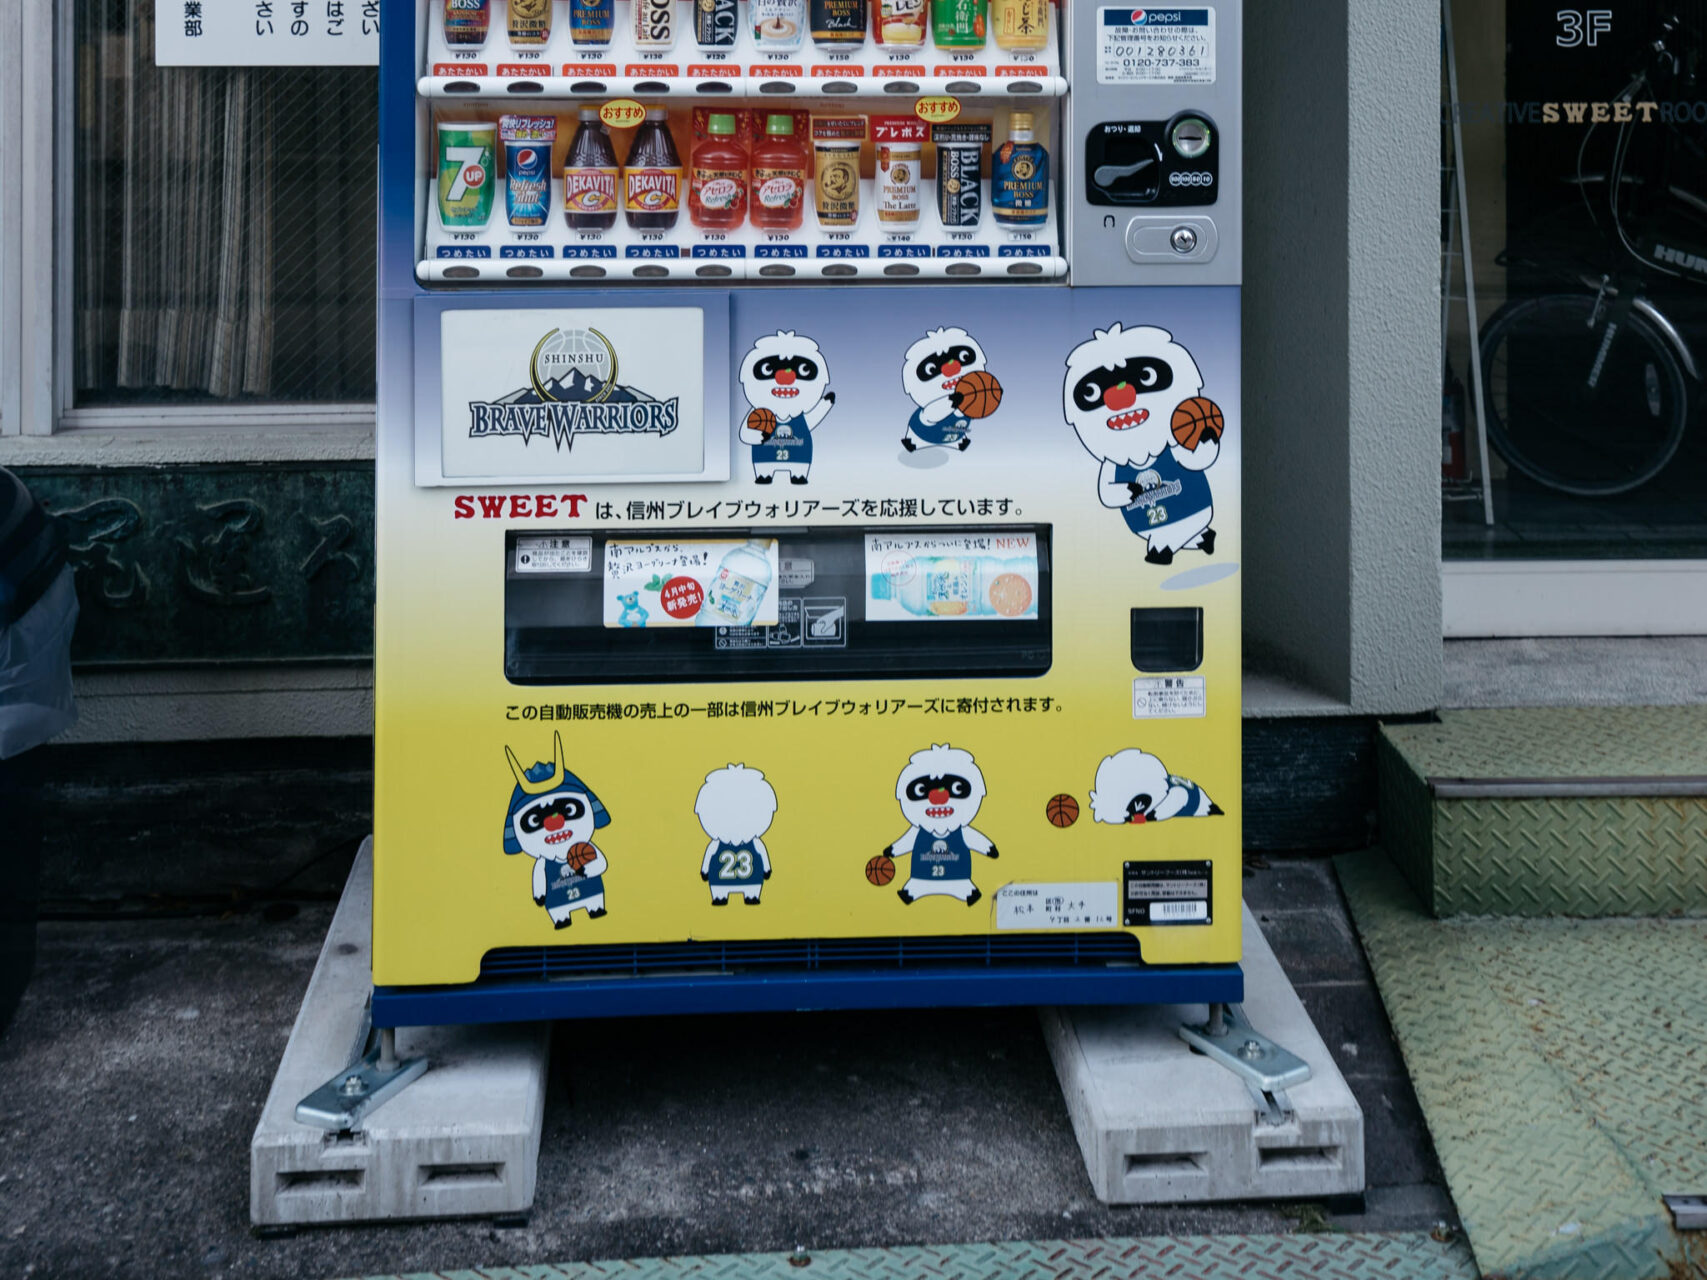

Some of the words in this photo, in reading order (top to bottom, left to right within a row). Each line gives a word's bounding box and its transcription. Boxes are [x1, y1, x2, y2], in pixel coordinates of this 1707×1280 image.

[824, 1, 858, 9] PREMIUM
[895, 0, 922, 11] レモン
[573, 9, 610, 19] PREMIUM
[832, 9, 851, 17] BOSS
[1149, 11, 1181, 24] pepsi
[1556, 10, 1612, 47] 3F
[1123, 58, 1200, 67] 0120-737-383
[603, 107, 644, 119] おすすめ
[918, 101, 958, 114] おすすめ
[1542, 102, 1658, 124] SWEET
[876, 126, 925, 138] プレボス
[950, 150, 960, 179] BOSS
[446, 146, 485, 201] 7
[466, 170, 483, 182] UP
[567, 174, 615, 201] DEKAVITA
[629, 174, 676, 201] DEKAVITA
[883, 186, 916, 194] PREMIUM
[960, 149, 980, 225] BLACK
[1003, 181, 1043, 190] PREMIUM
[582, 190, 600, 206] C
[644, 190, 662, 206] C
[883, 201, 897, 209] The
[442, 249, 486, 258] つめたい
[505, 249, 549, 258] つめたい
[568, 249, 612, 258] つめたい
[630, 249, 674, 258] つめたい
[697, 248, 742, 257] つめたい
[760, 248, 803, 257] つめたい
[821, 249, 865, 257] つめたい
[883, 249, 926, 257] つめたい
[942, 249, 985, 257] つめたい
[1004, 249, 1046, 257] つめたい
[544, 352, 604, 365] SHINSHU
[470, 400, 550, 447] BRAVE
[550, 397, 679, 453] WARRIORS
[775, 449, 790, 461] 23
[454, 494, 588, 519] SWEET
[595, 497, 1023, 521] は、信州ブレイブウォリアーズを応援しています。
[1146, 504, 1169, 526] 23
[996, 537, 1030, 549] NEW
[664, 581, 695, 599] 4月中旬
[666, 591, 702, 612] 新発売!
[505, 696, 1062, 722] この自動販売機の売上の一部は信州ブレイブウォリアーズに寄付されます。
[718, 849, 754, 879] 23
[932, 865, 946, 877] 23
[567, 888, 580, 901] 23
